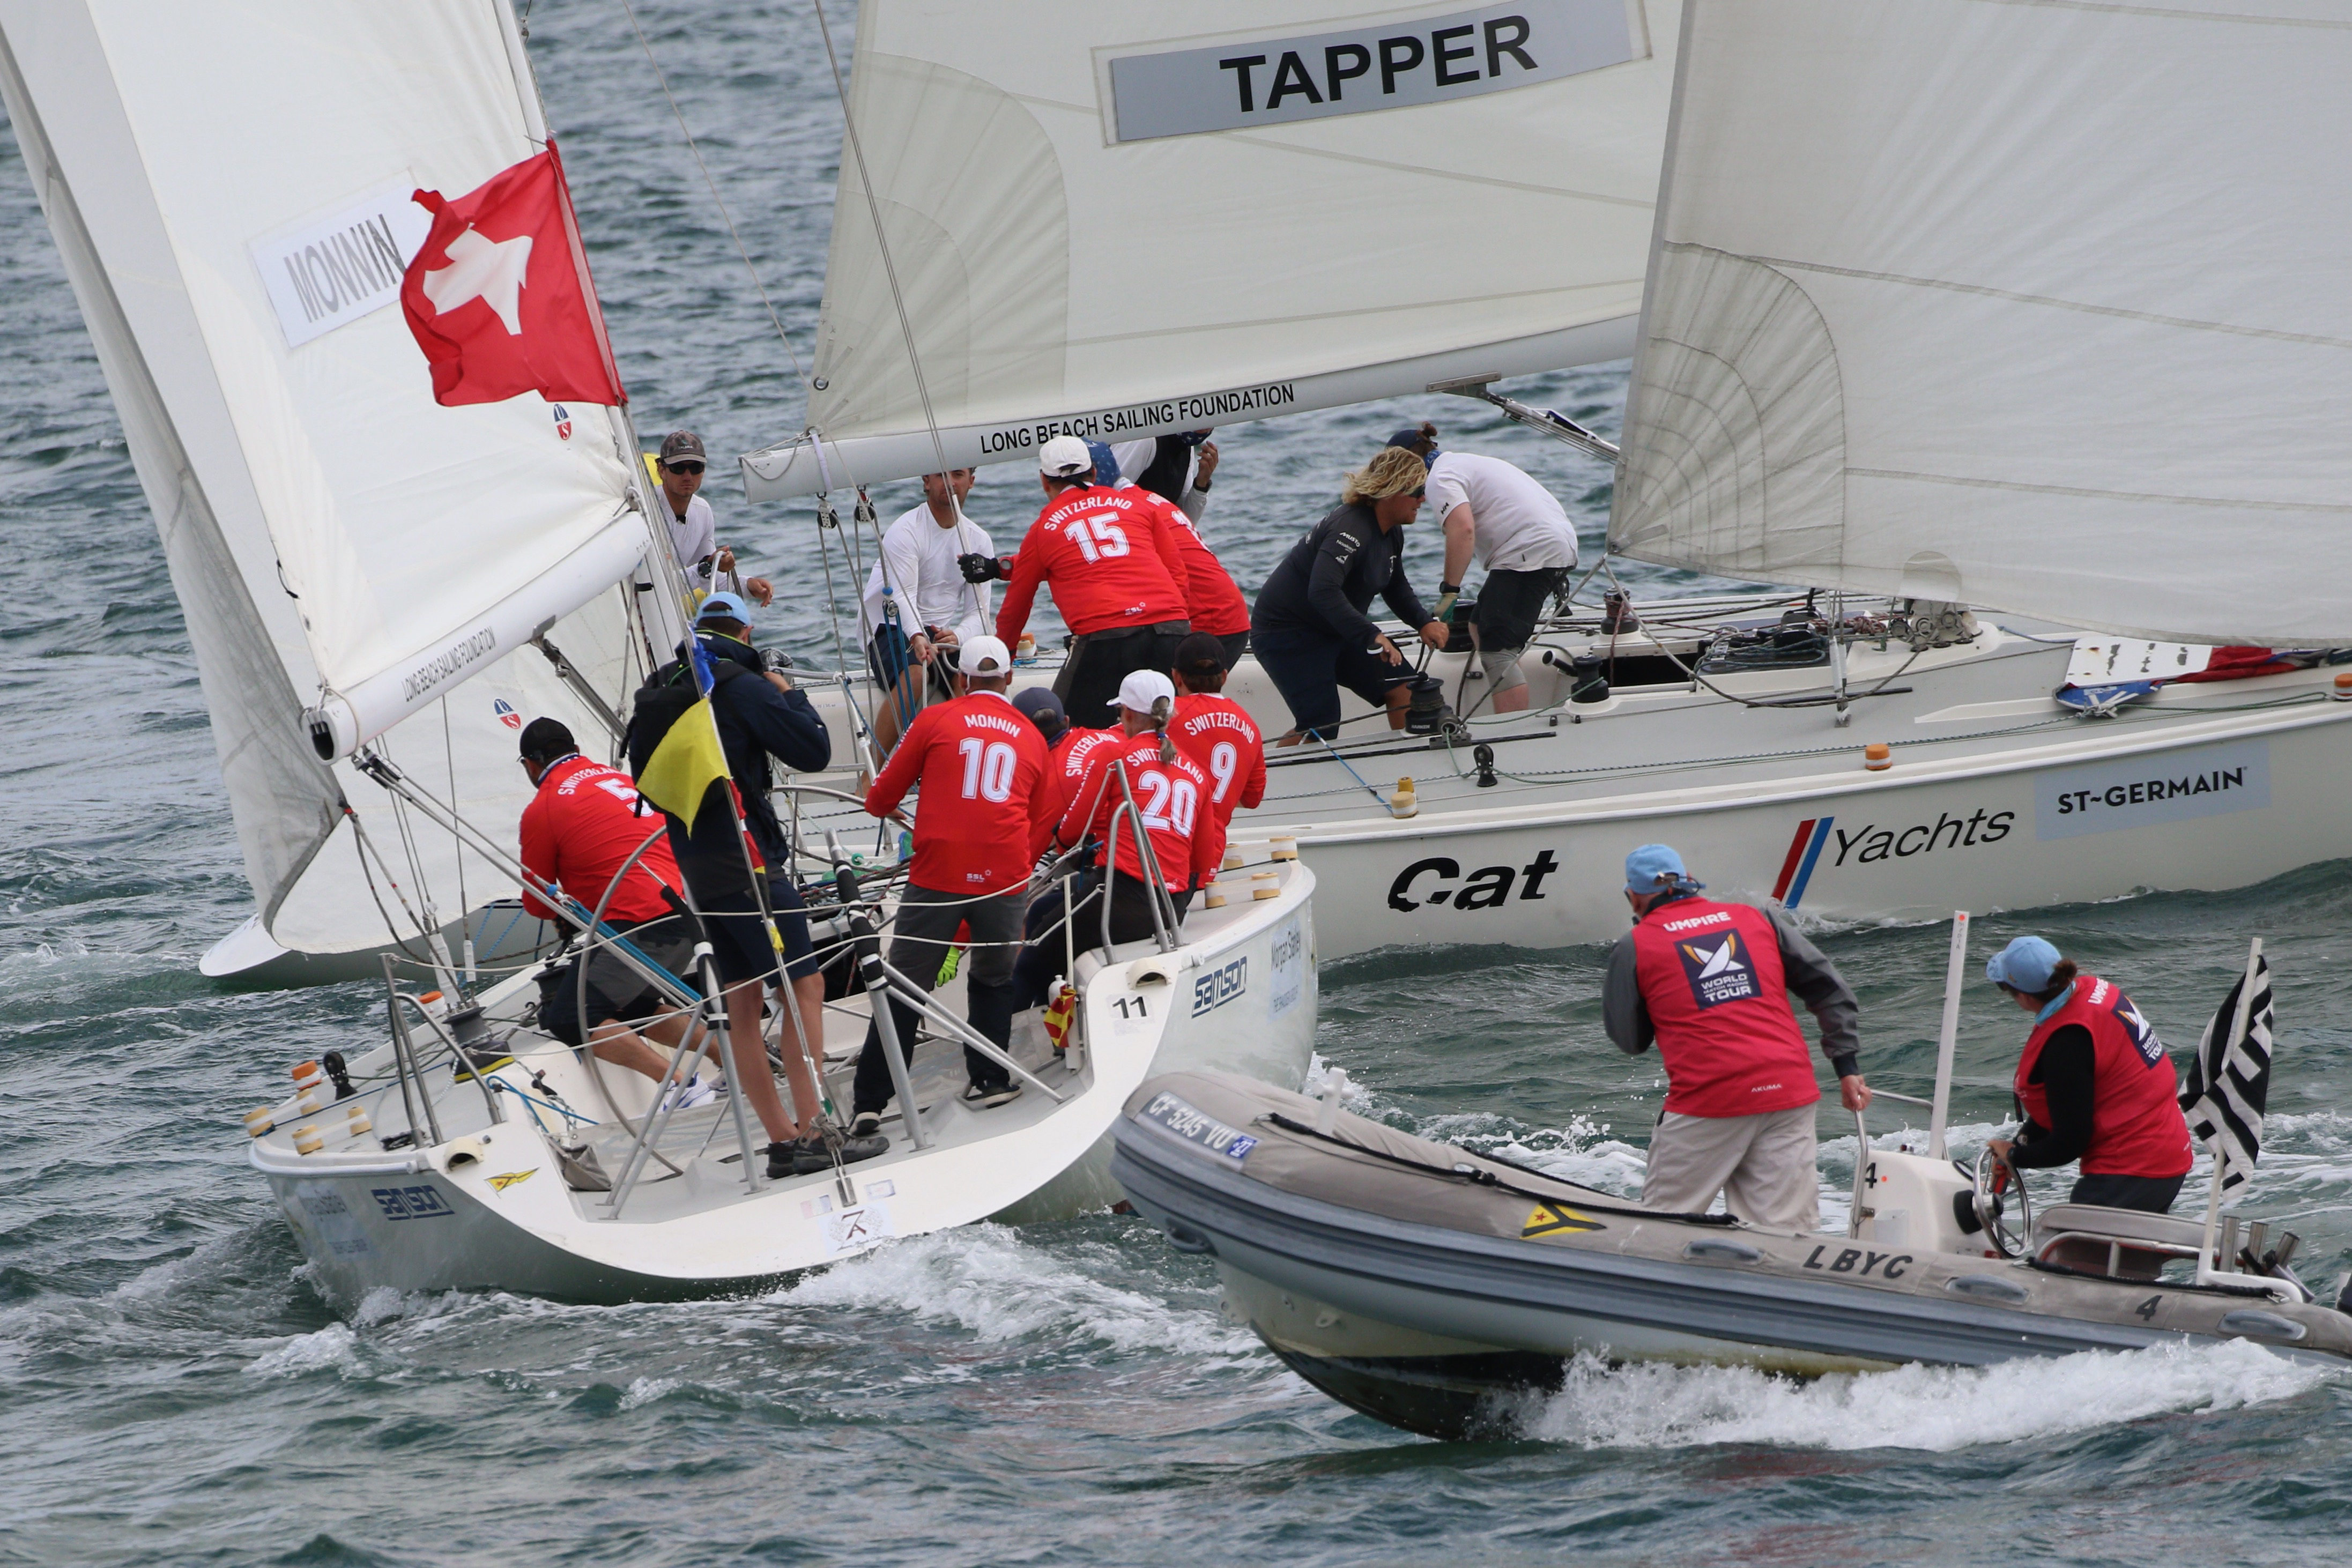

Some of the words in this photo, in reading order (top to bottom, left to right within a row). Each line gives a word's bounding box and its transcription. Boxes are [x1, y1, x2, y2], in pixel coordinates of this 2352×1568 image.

[1219, 15, 1539, 113] TAPPER
[283, 213, 406, 323] MONNIN
[982, 428, 1031, 455] LONG
[1103, 404, 1174, 433] SAILING
[1179, 384, 1295, 420] FOUNDATION
[1044, 496, 1132, 531] SWITZERLAND
[1064, 511, 1130, 564] 15
[1340, 532, 1361, 547] MUSTO
[401, 673, 421, 702] LONG
[417, 661, 440, 692] BEACH
[436, 646, 461, 679] SAILING
[457, 626, 495, 666] FOUNDATION
[964, 714, 1021, 738] MONNIN
[1184, 711, 1255, 744] SWITZERLAND
[959, 737, 1017, 803] 10
[1210, 741, 1237, 803] 9
[1138, 770, 1198, 838] 20
[1835, 807, 2015, 867] Yachts
[1388, 850, 1559, 912] Cat
[1663, 911, 1732, 932] UMPIRE
[1701, 973, 1747, 990] WORLD
[1703, 985, 1725, 994] MATCH
[1705, 985, 1752, 1001] TOUR
[1112, 996, 1147, 1019] 11
[1752, 1083, 1782, 1093] AKUMA
[1149, 1095, 1177, 1116] CF
[1167, 1107, 1209, 1138] 5245
[1204, 1125, 1236, 1149] VU
[1865, 1162, 1878, 1188] 4
[1802, 1245, 1913, 1279] LBYC
[2135, 1295, 2163, 1321] 4
